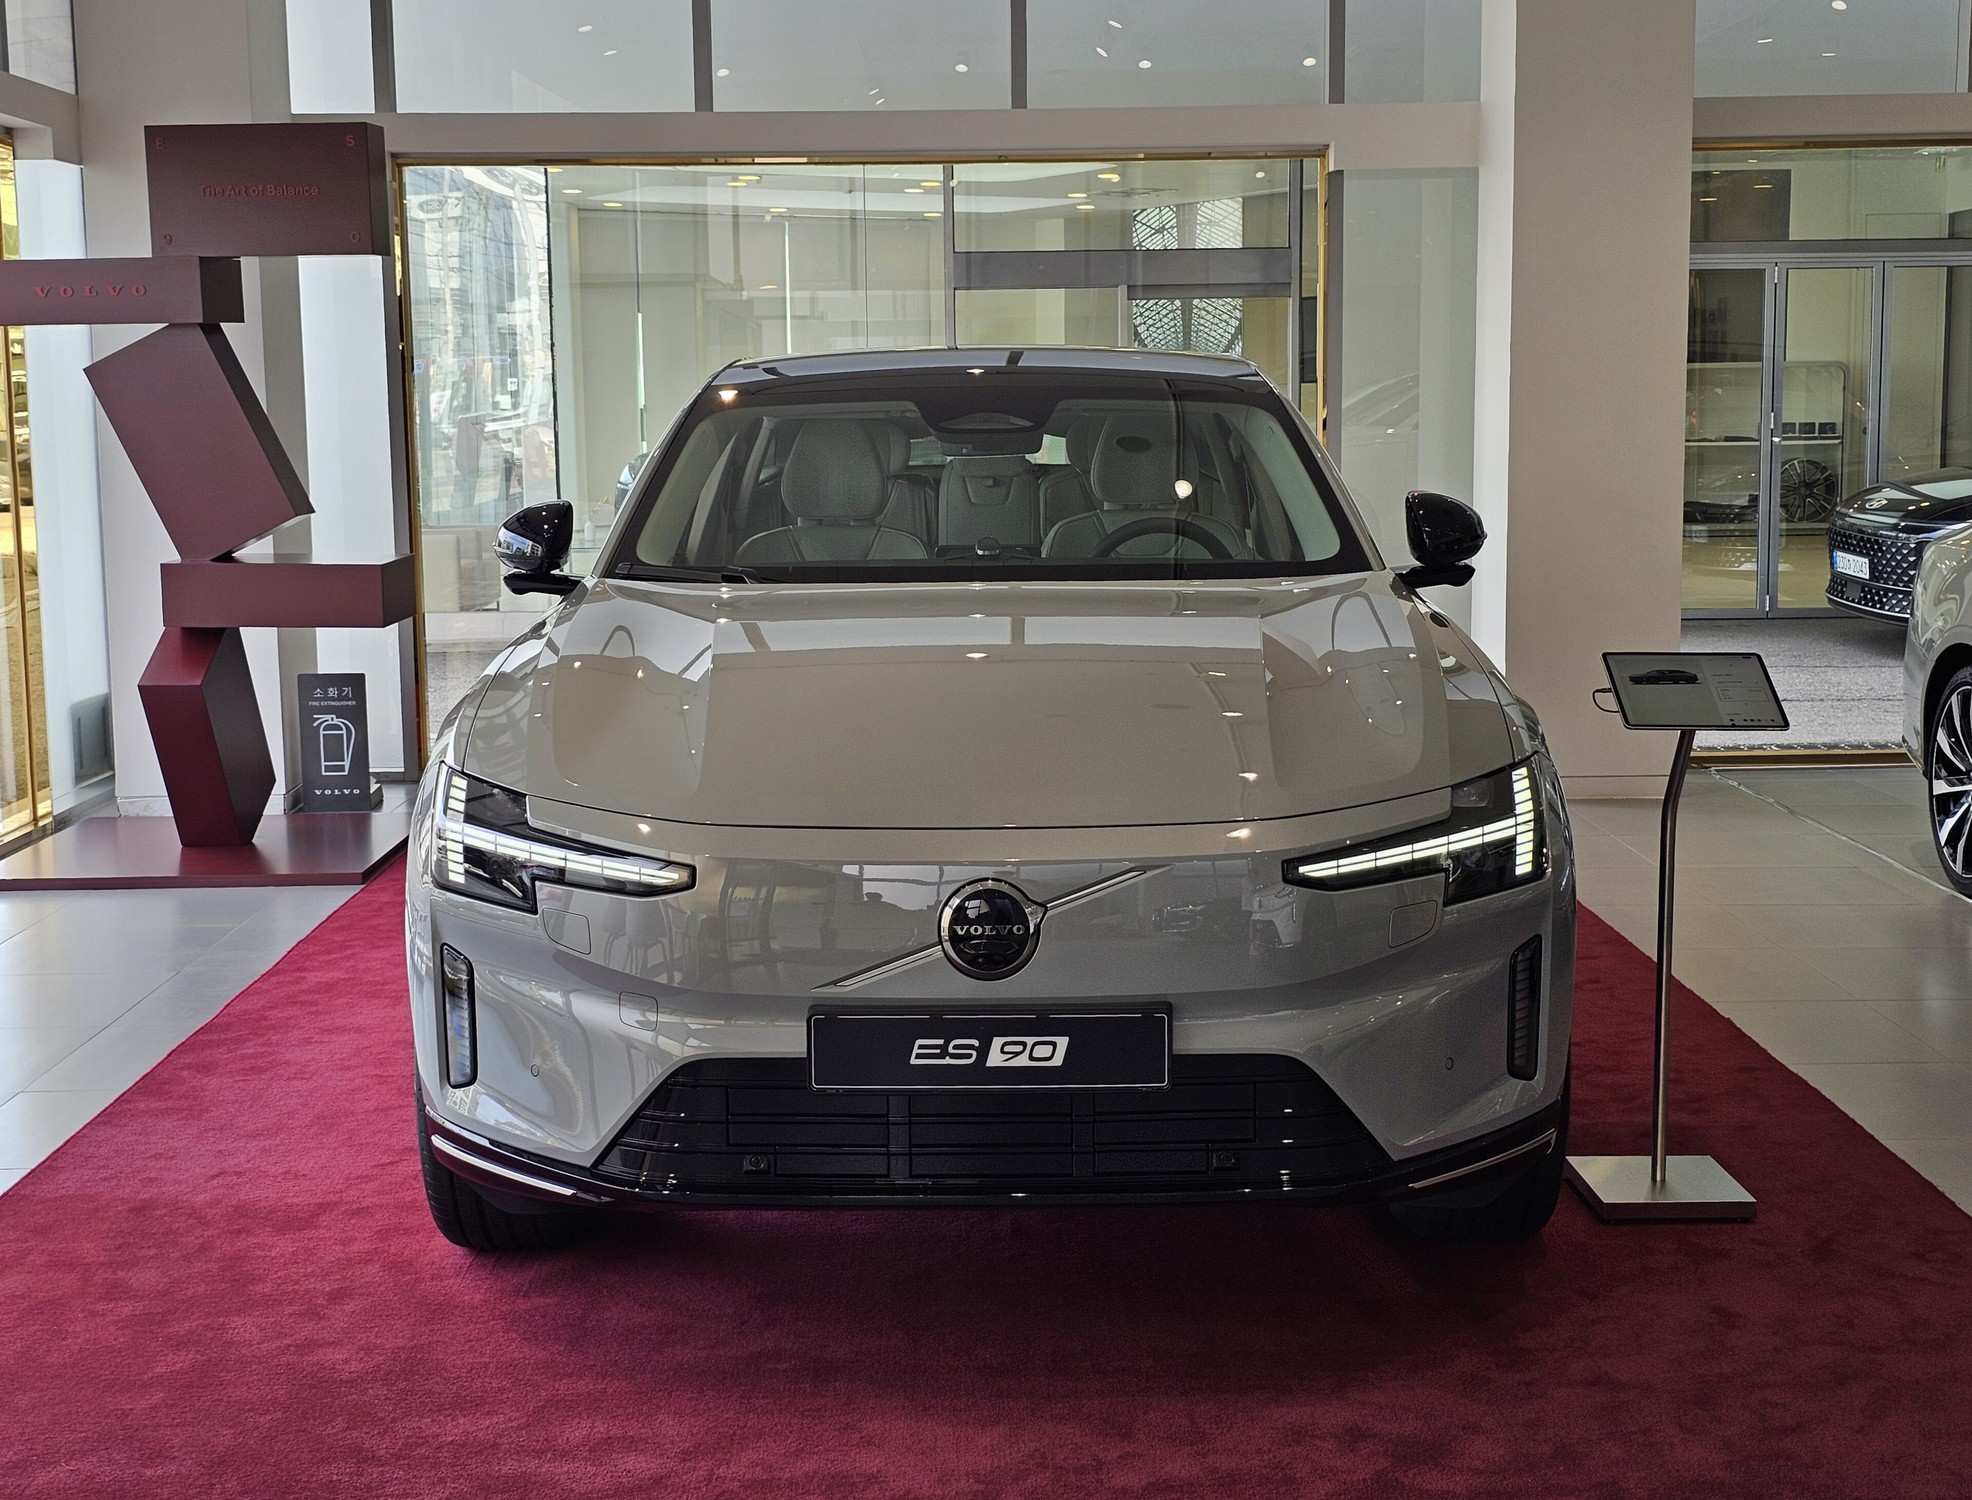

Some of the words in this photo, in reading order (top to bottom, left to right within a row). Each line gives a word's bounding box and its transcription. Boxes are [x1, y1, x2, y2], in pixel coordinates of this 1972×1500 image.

[155, 137, 164, 150] E
[345, 134, 356, 148] S
[200, 185, 224, 197] The
[226, 185, 248, 197] Art
[250, 184, 265, 196] of
[267, 184, 319, 196] Balance
[163, 232, 173, 246] 9
[34, 284, 147, 298] VOLVO
[313, 687, 352, 698] 소화기
[952, 924, 1026, 936] VOLVO
[909, 1038, 980, 1066] ES
[999, 1040, 1058, 1062] 90
